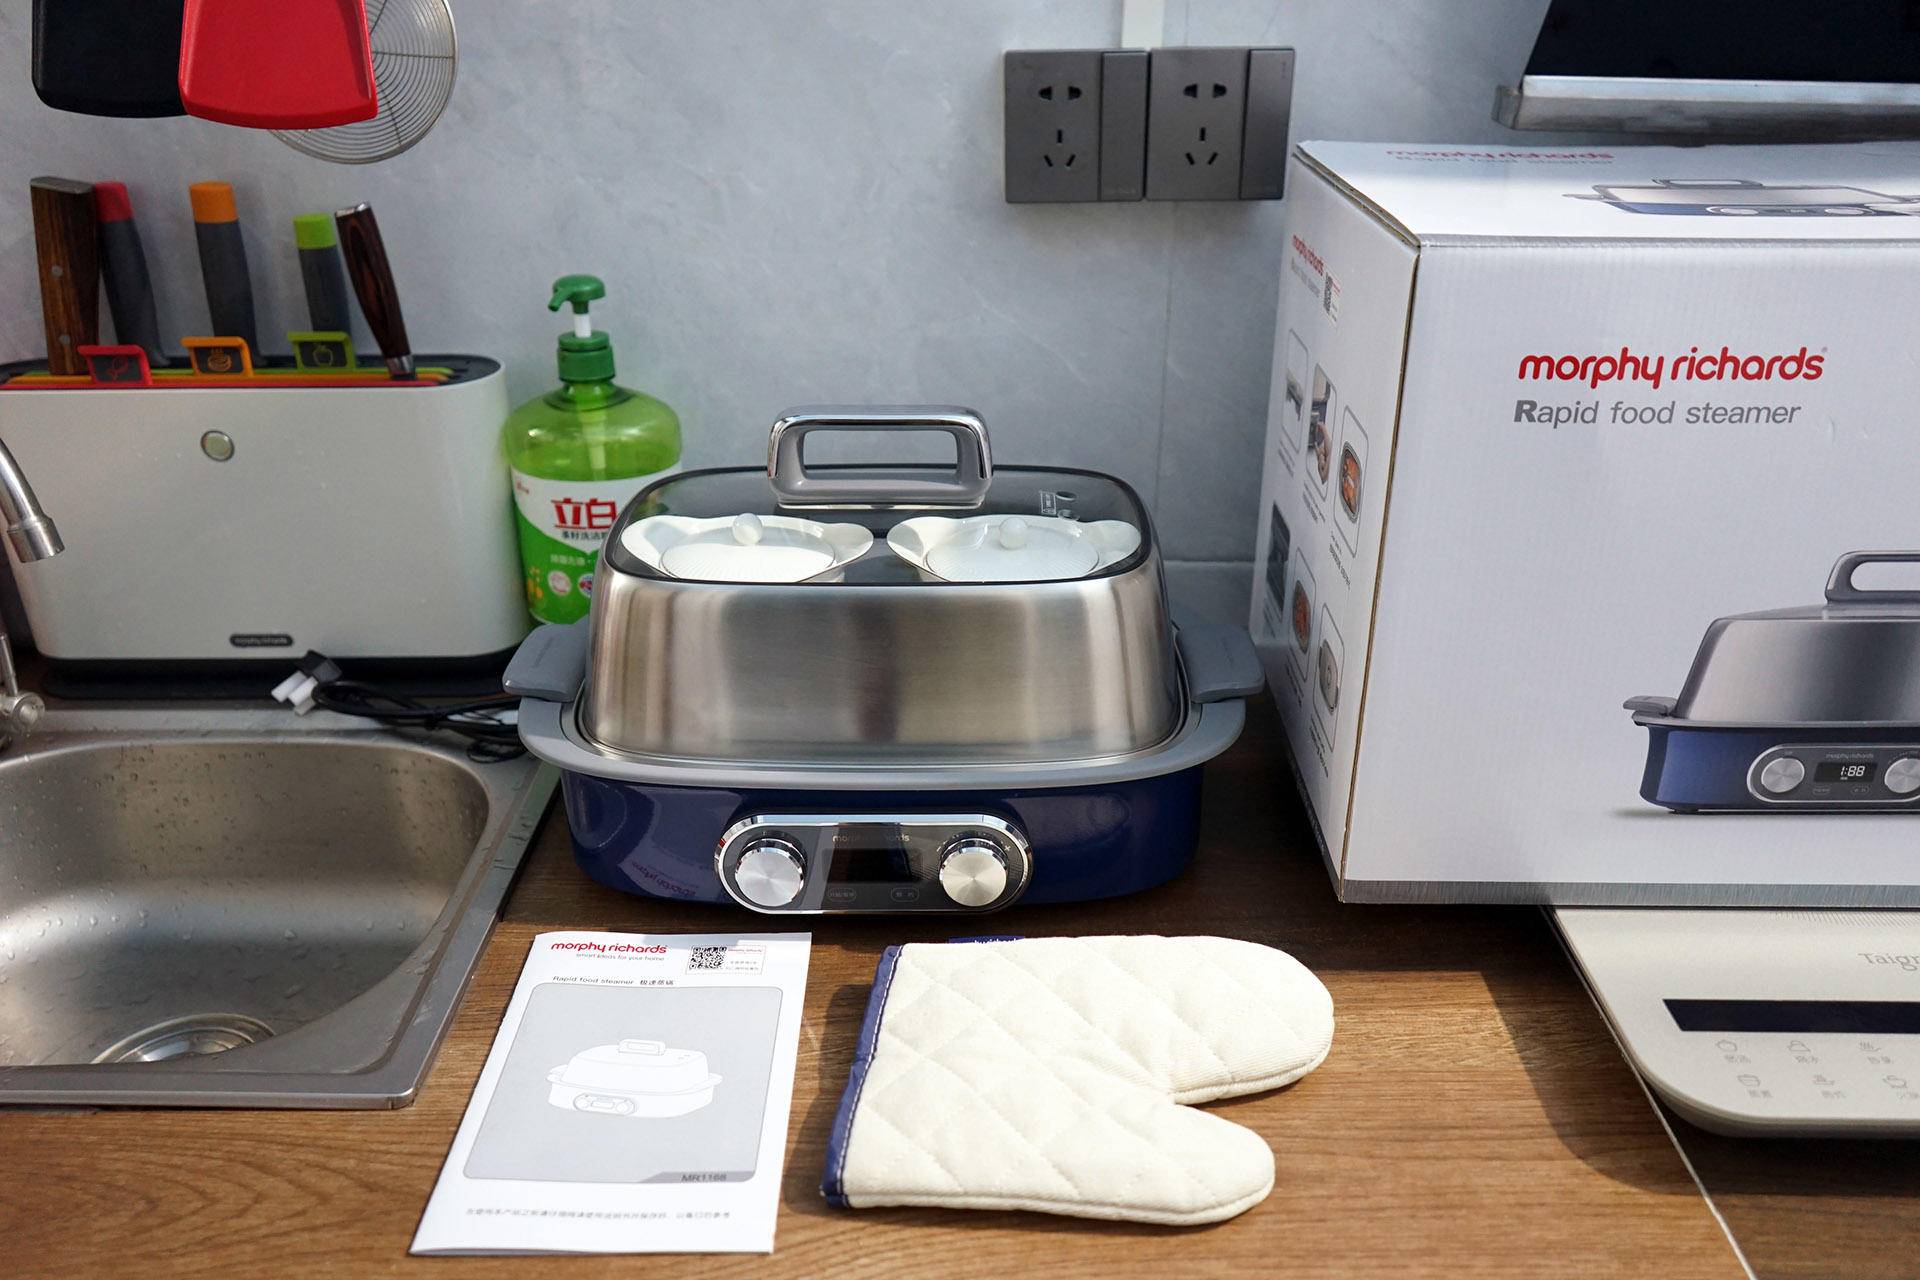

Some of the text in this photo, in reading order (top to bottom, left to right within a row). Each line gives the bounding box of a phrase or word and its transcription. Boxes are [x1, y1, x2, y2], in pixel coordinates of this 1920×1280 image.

[1518, 346, 1825, 389] morphy richards
[1513, 399, 1802, 429] Rapid food steamer
[551, 498, 617, 529] 立白
[1840, 765, 1866, 777] 1:88
[550, 941, 668, 954] morphy richards
[552, 976, 577, 984] Rapid
[681, 1173, 727, 1182] MR1168
